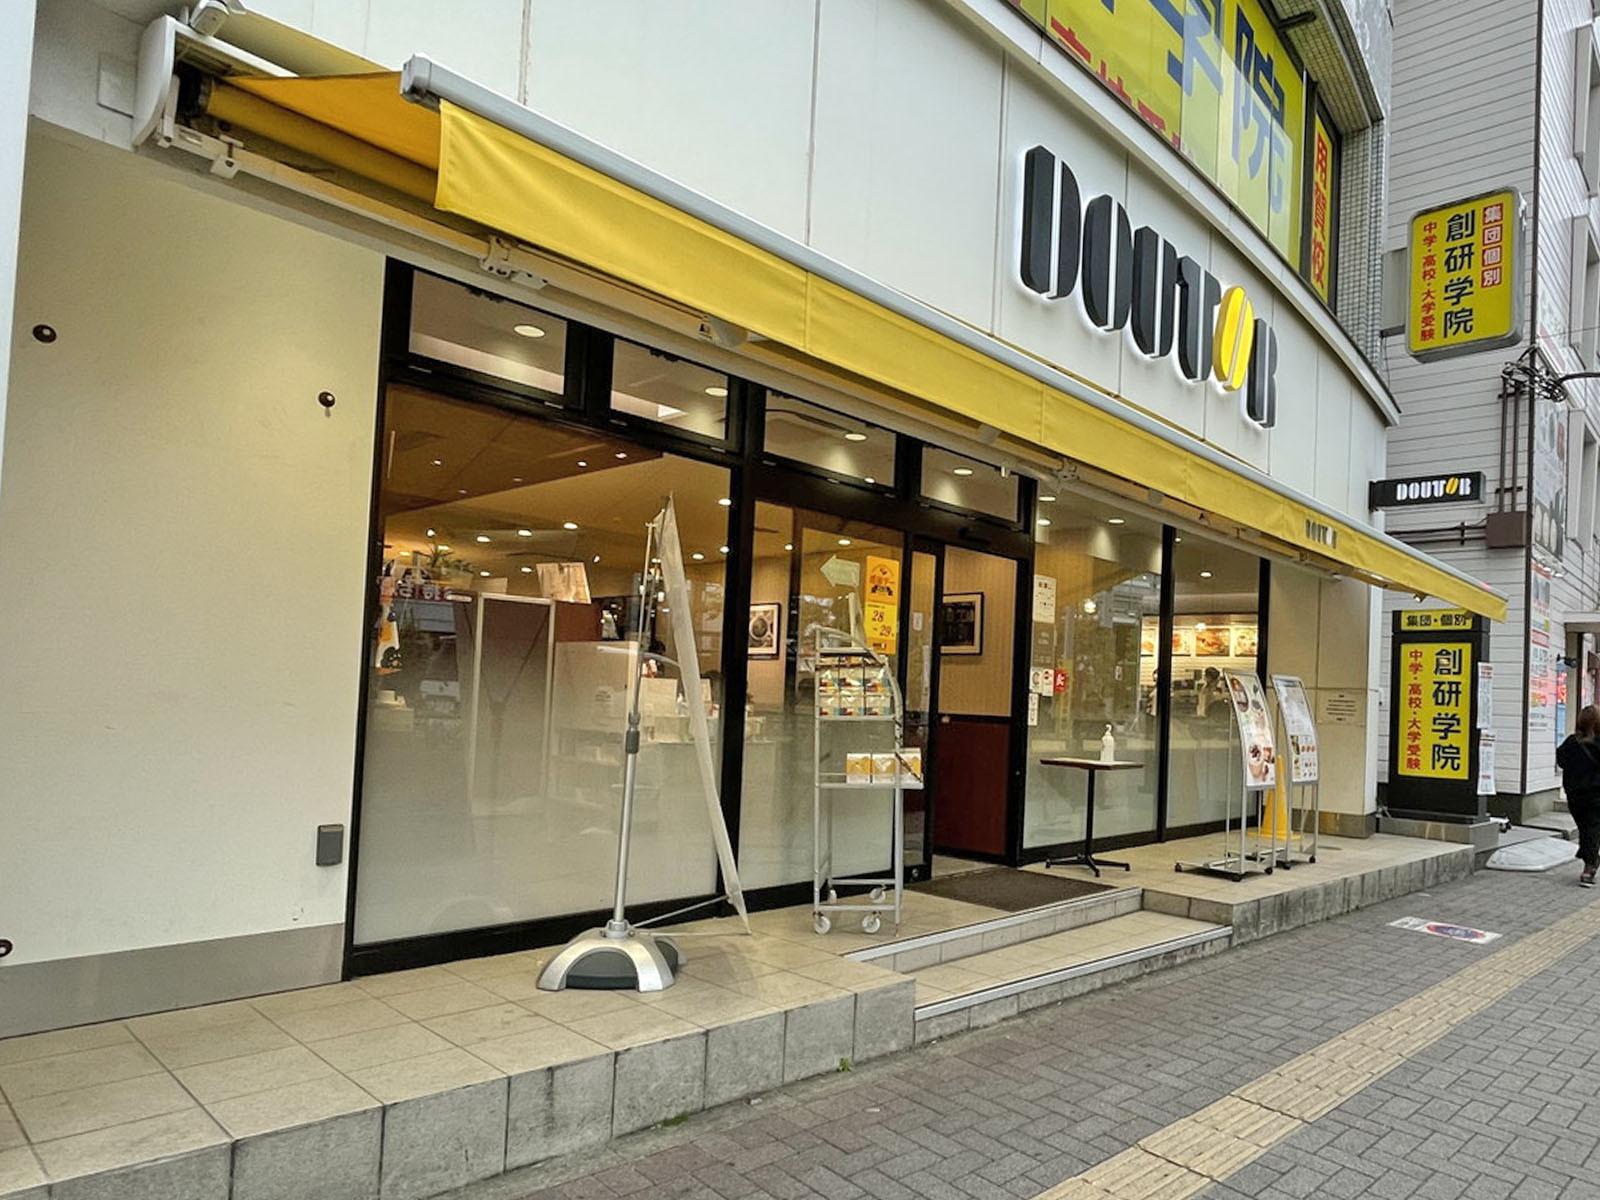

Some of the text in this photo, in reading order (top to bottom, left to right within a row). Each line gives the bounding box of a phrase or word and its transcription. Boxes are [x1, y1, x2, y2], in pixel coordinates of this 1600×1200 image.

[1019, 144, 1279, 430] DOUTOR
[1443, 209, 1475, 339] 創研学院
[1481, 203, 1504, 288] 集団個別
[1396, 477, 1471, 501] DOUTOR
[1406, 613, 1467, 627] 集団・個別
[1431, 648, 1463, 771] 創研学院
